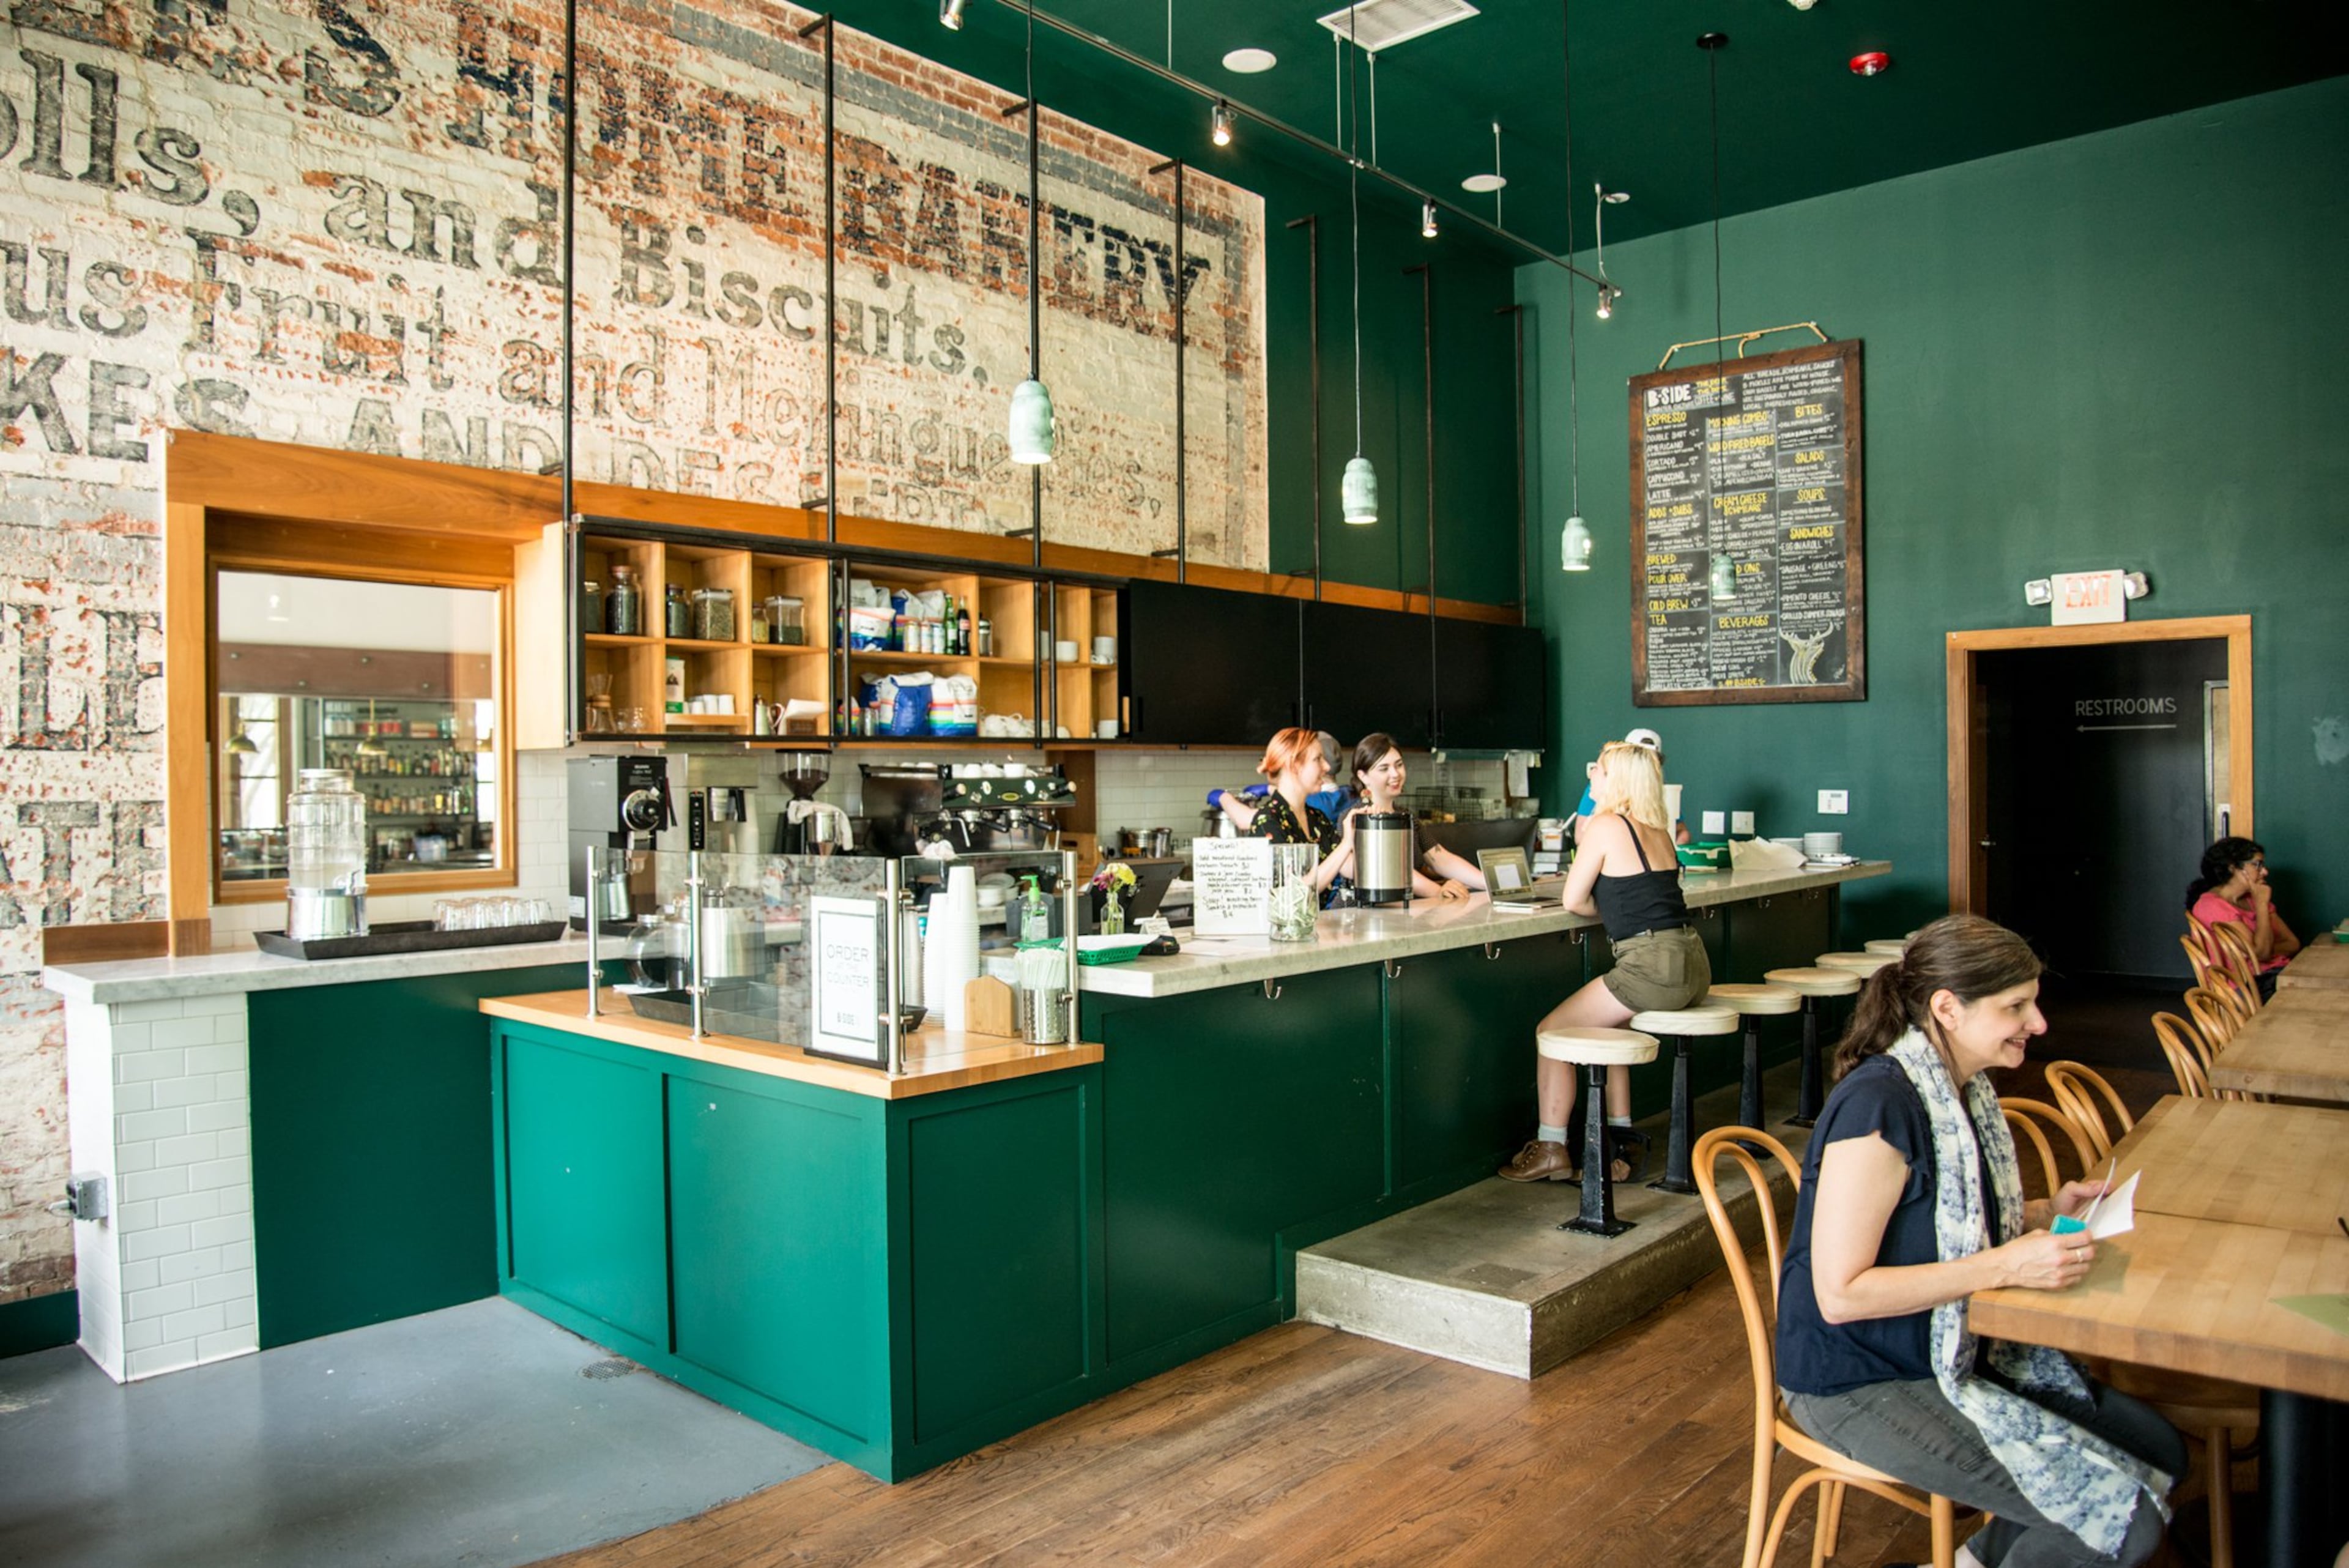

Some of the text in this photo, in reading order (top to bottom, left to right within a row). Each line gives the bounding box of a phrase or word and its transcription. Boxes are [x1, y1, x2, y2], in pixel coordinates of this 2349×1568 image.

[324, 174, 565, 288] and
[1647, 384, 1691, 407] B-SIDE
[1742, 410, 1767, 425] COMBO
[1795, 404, 1823, 418] BITES
[1646, 412, 1687, 426] ESPRESSO
[1795, 450, 1825, 464] SALADS
[1647, 489, 1671, 500] LATTE
[1740, 493, 1767, 505] CHEESE
[1797, 488, 1825, 502] SOUPS
[1790, 526, 1834, 540] SANDWICHES
[1647, 554, 1676, 565] BREWED
[1647, 573, 1687, 584] POUR OVER
[2065, 574, 2112, 608] EXIT
[1649, 599, 1688, 611] COLD BREW
[1649, 614, 1667, 625] TEA
[1719, 615, 1769, 629] BEVERAGES
[2075, 697, 2177, 716] RESTROOMS
[827, 944, 869, 962] ORDER
[827, 972, 869, 988] COUNTER
